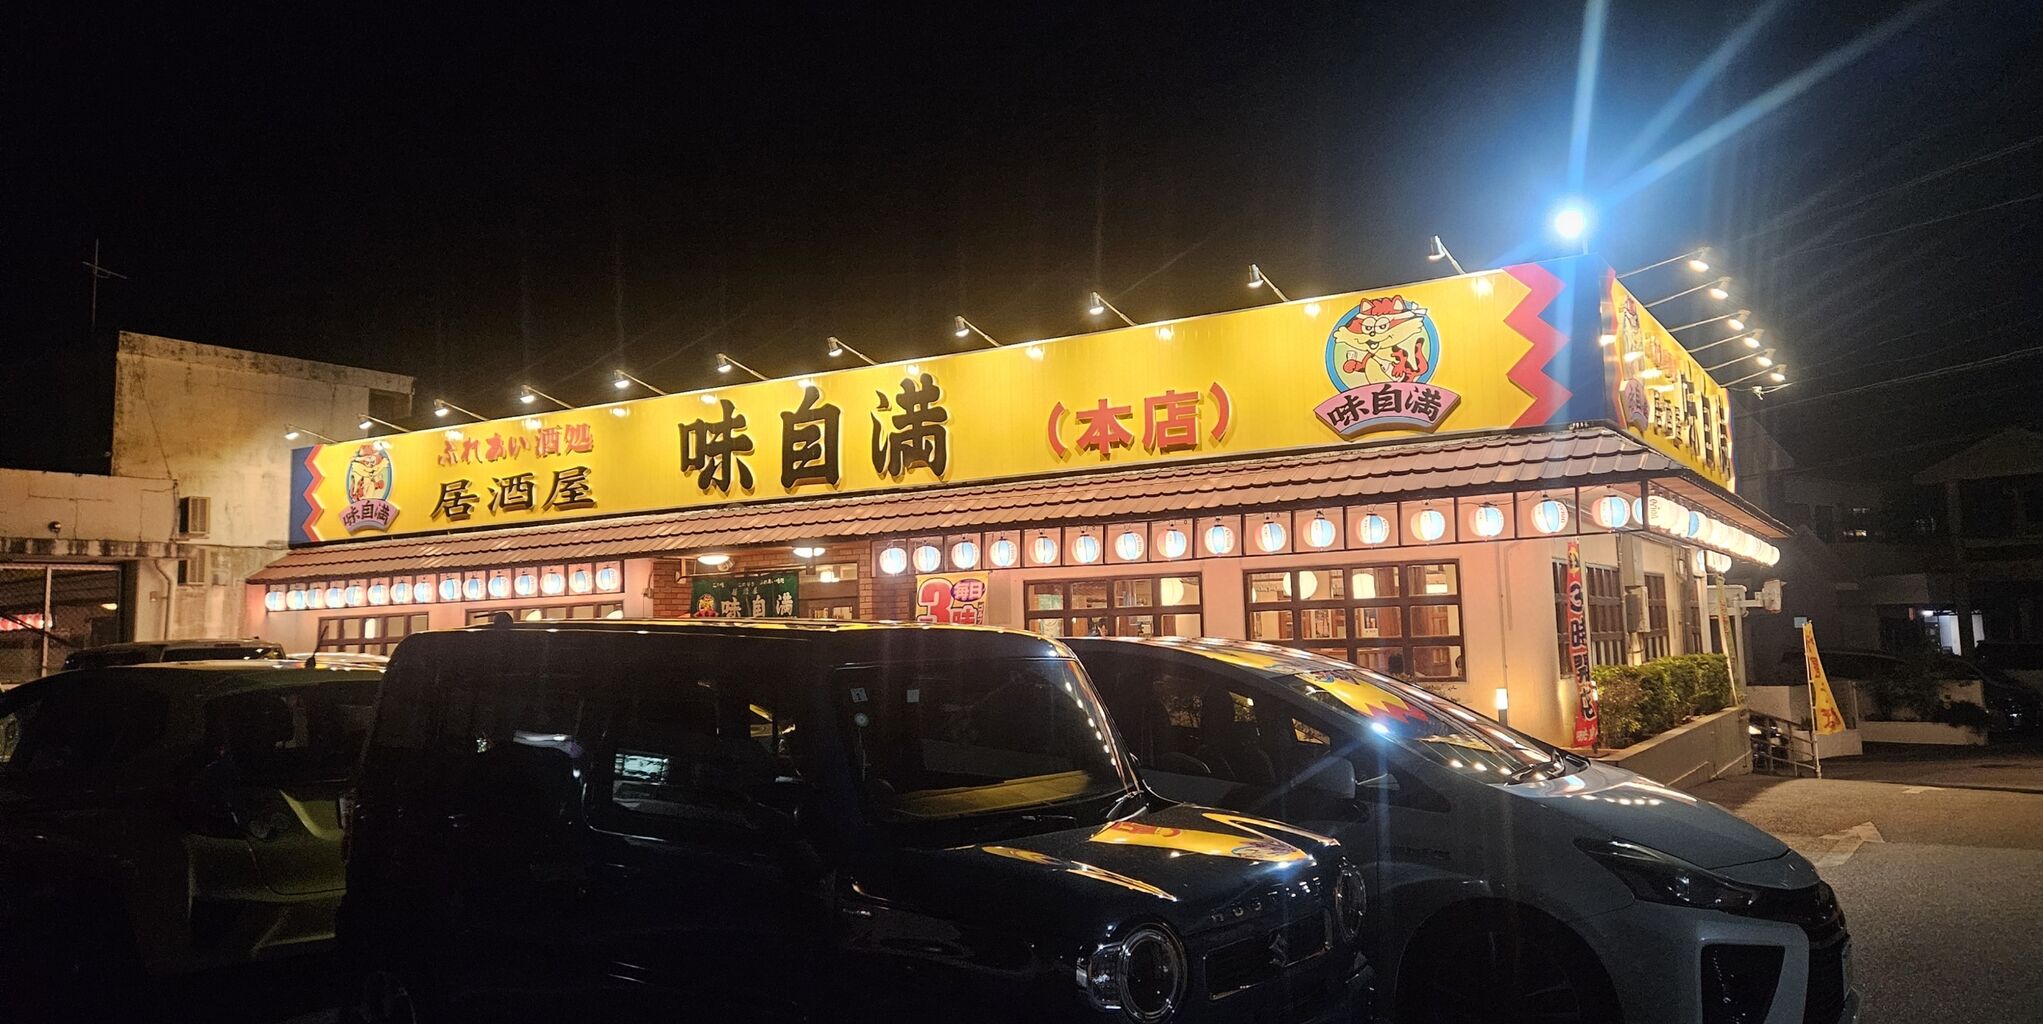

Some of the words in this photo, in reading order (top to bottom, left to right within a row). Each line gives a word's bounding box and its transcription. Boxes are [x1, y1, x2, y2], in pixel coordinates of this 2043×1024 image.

[1048, 382, 1230, 458] （本店）
[1327, 384, 1442, 426] 味自満
[437, 423, 594, 467] ふれあい酒処
[678, 373, 949, 497] 味自満
[343, 500, 390, 526] 味自満
[430, 466, 598, 522] 居酒屋
[720, 592, 794, 618] 味自満
[954, 580, 984, 601] 毎日
